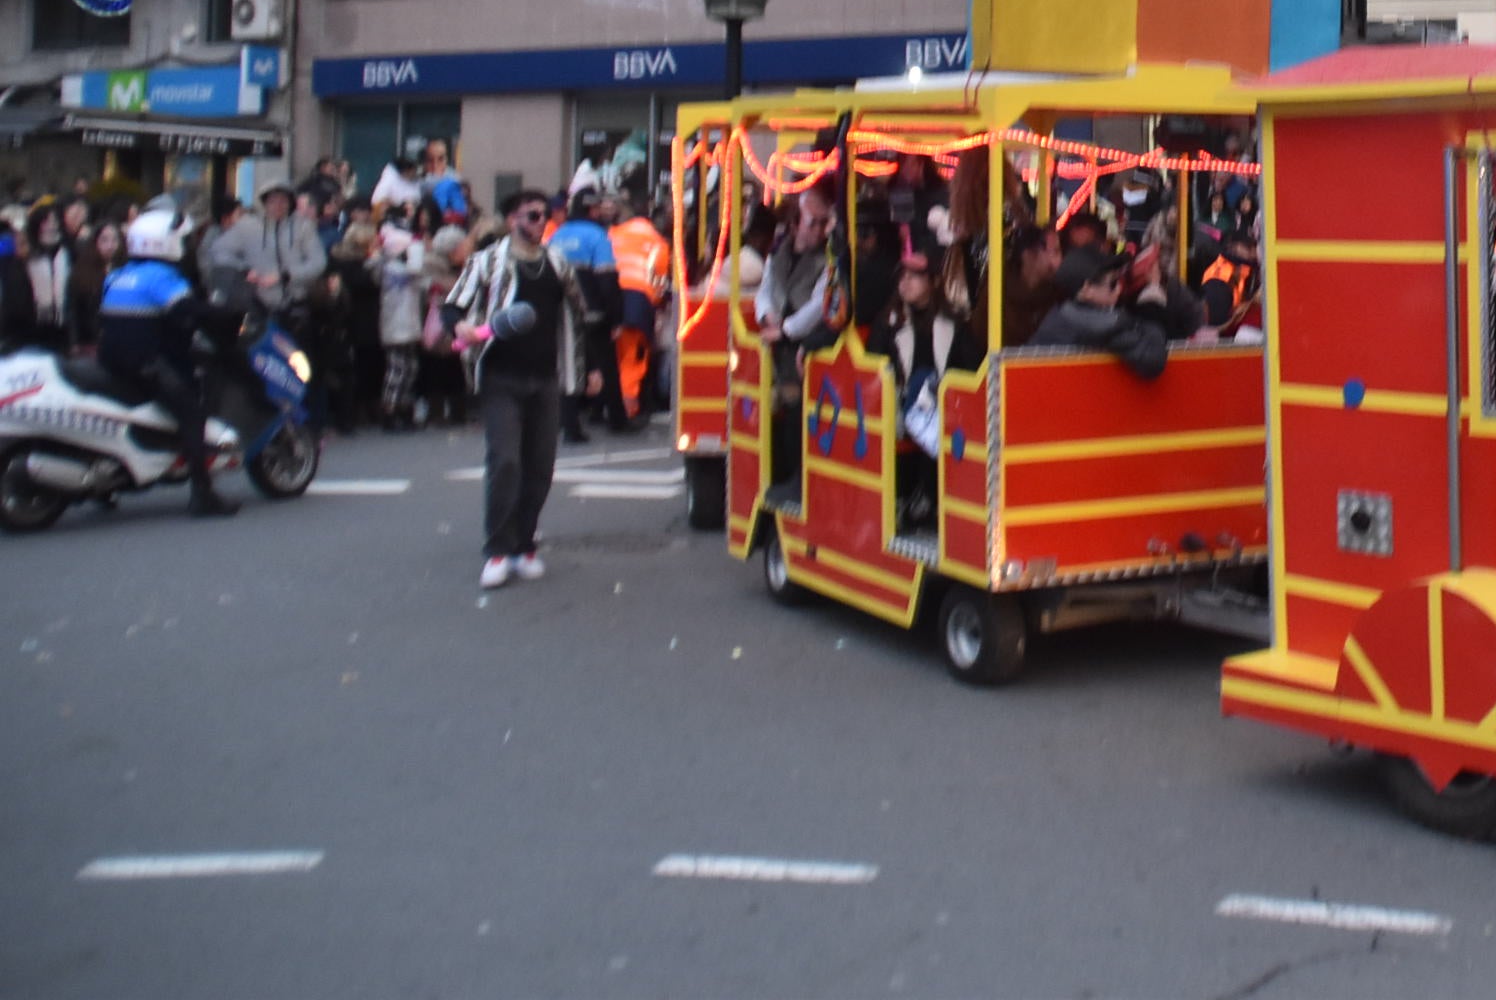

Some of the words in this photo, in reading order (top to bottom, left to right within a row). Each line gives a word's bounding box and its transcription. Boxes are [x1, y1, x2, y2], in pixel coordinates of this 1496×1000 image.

[363, 58, 418, 88] BBVA
[613, 47, 677, 80] BBVA
[150, 82, 214, 104] movistar
